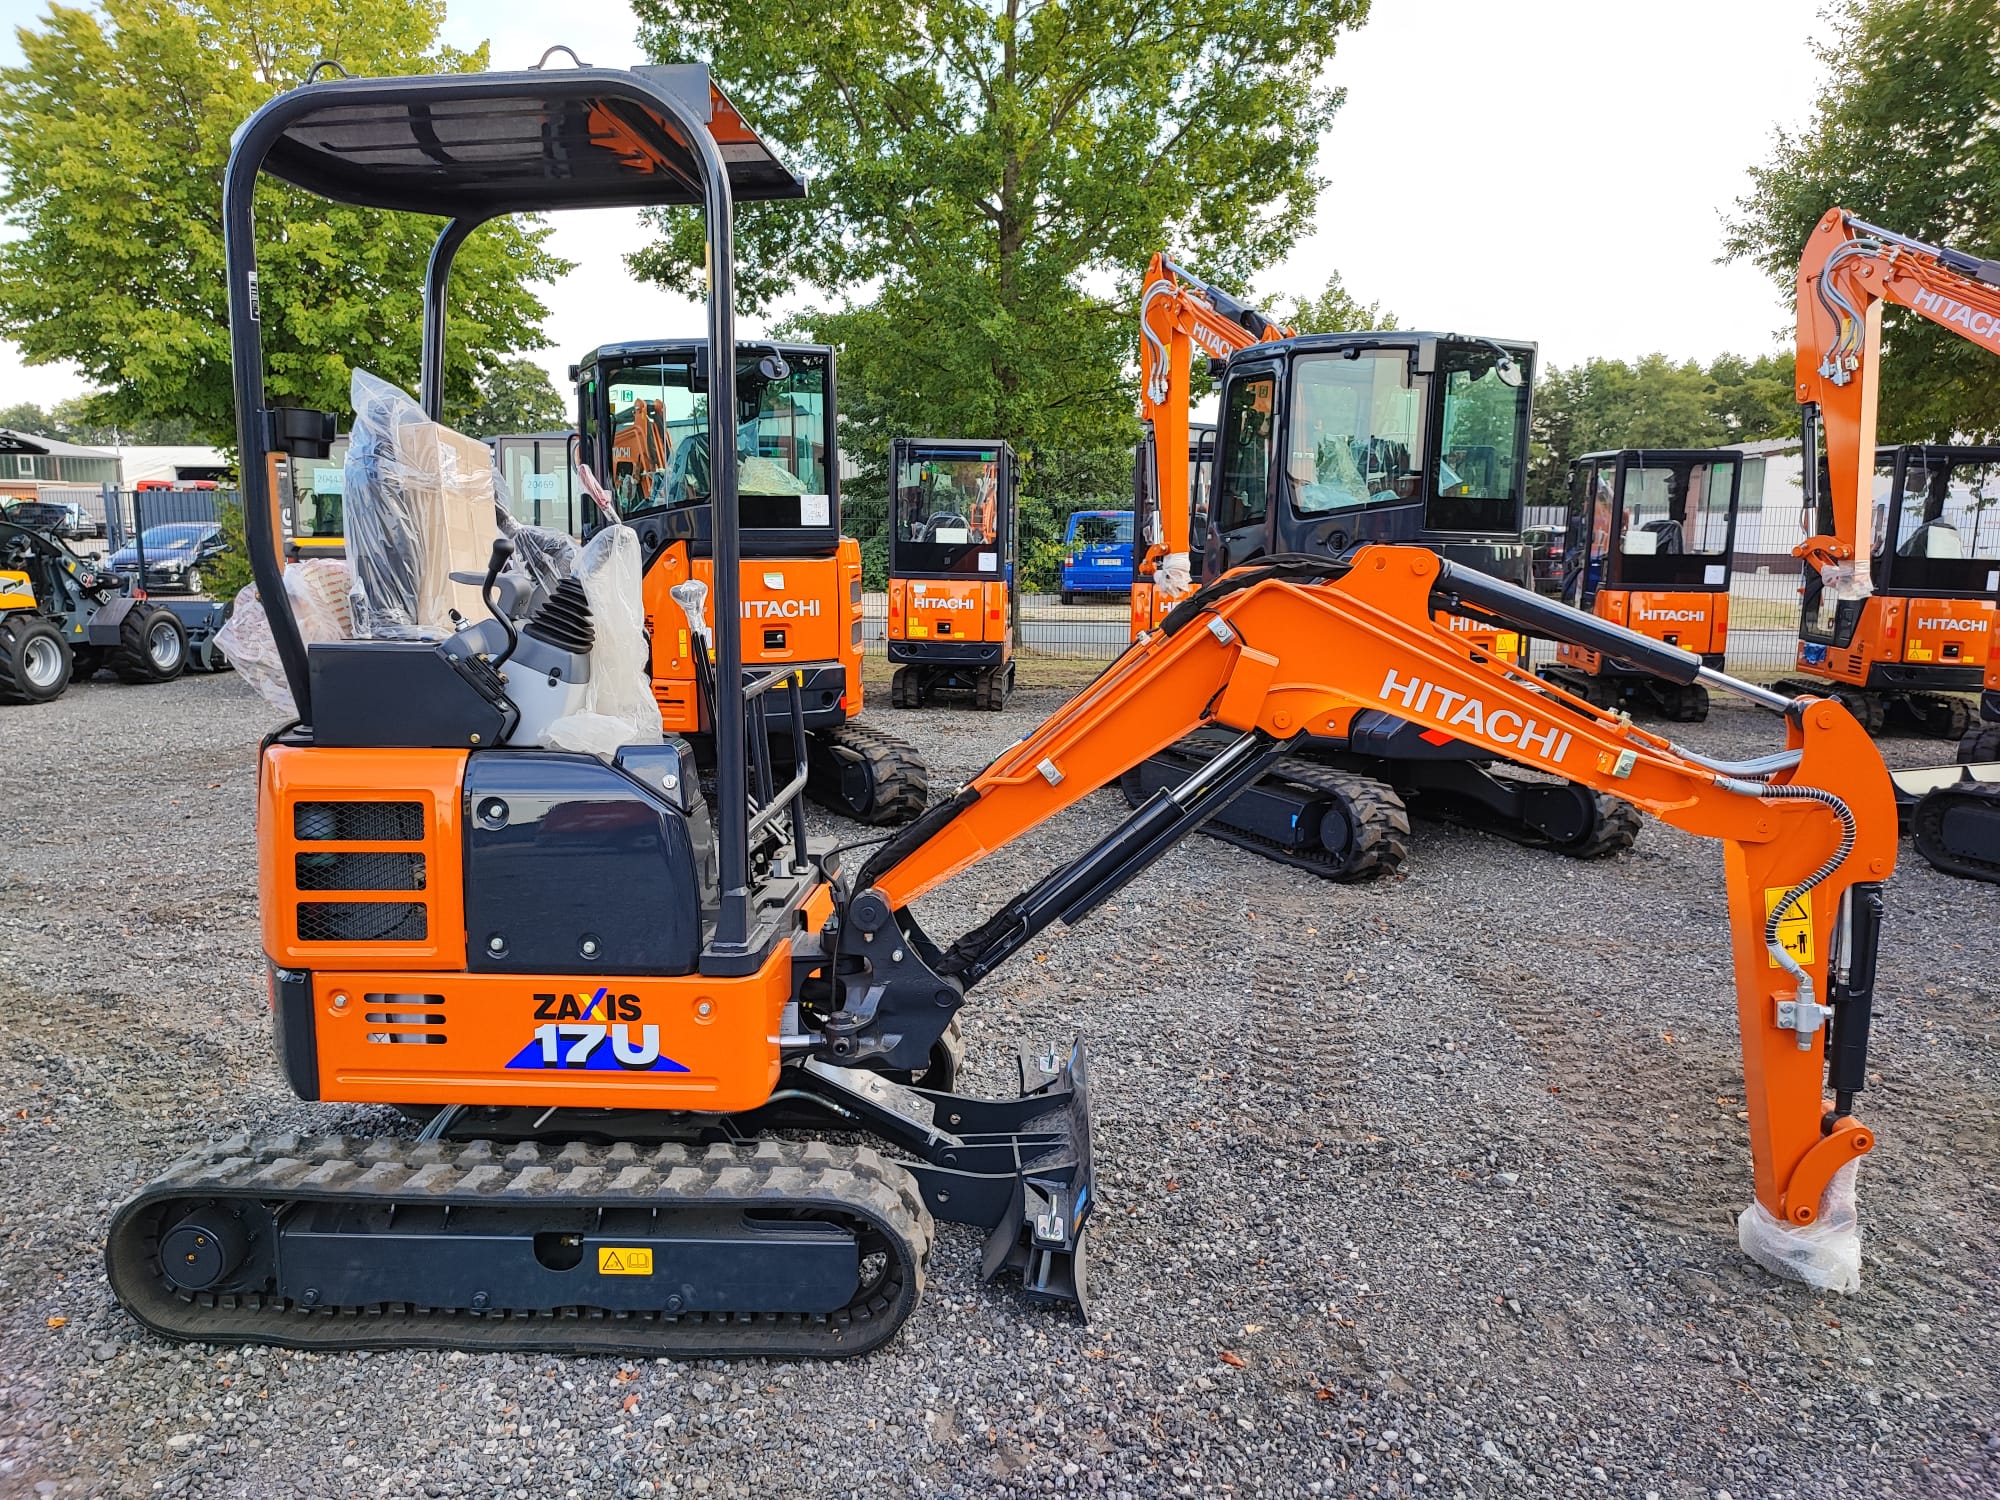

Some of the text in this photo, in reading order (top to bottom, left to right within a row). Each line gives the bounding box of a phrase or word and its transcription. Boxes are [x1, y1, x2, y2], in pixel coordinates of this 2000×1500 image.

[527, 480, 554, 489] 20469
[914, 597, 974, 610] HITACHI
[1639, 609, 1705, 622] HITACHI
[1917, 617, 1988, 632] HITACHI
[1378, 669, 1573, 763] HITACHI
[532, 988, 642, 1022] ZAXIS
[534, 1023, 660, 1071] 17U
